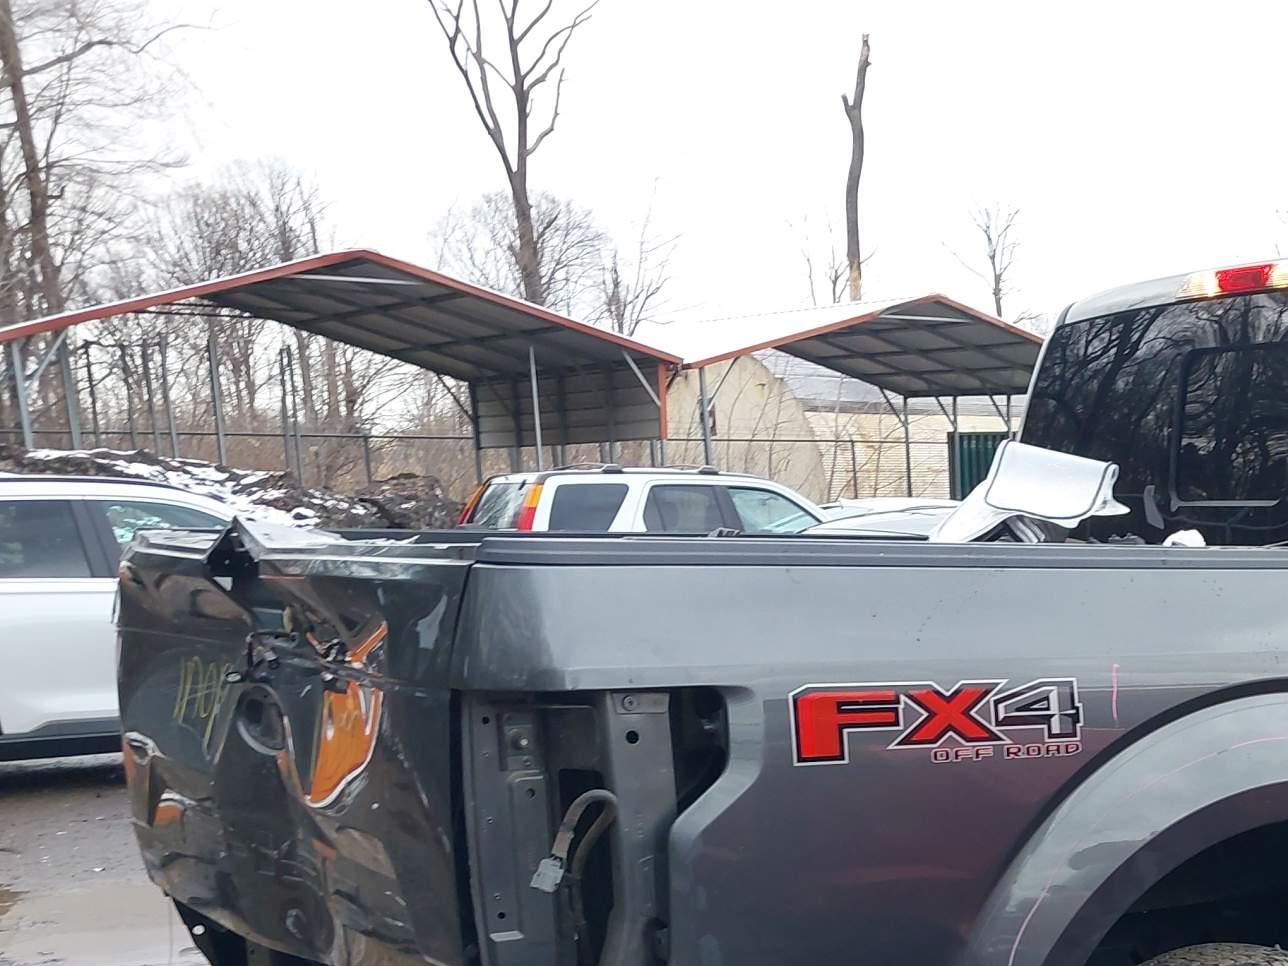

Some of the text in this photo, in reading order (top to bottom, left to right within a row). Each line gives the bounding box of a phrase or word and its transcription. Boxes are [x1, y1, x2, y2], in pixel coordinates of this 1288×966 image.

[787, 678, 1083, 766] FX4
[931, 740, 1083, 763] OFF ROAD
